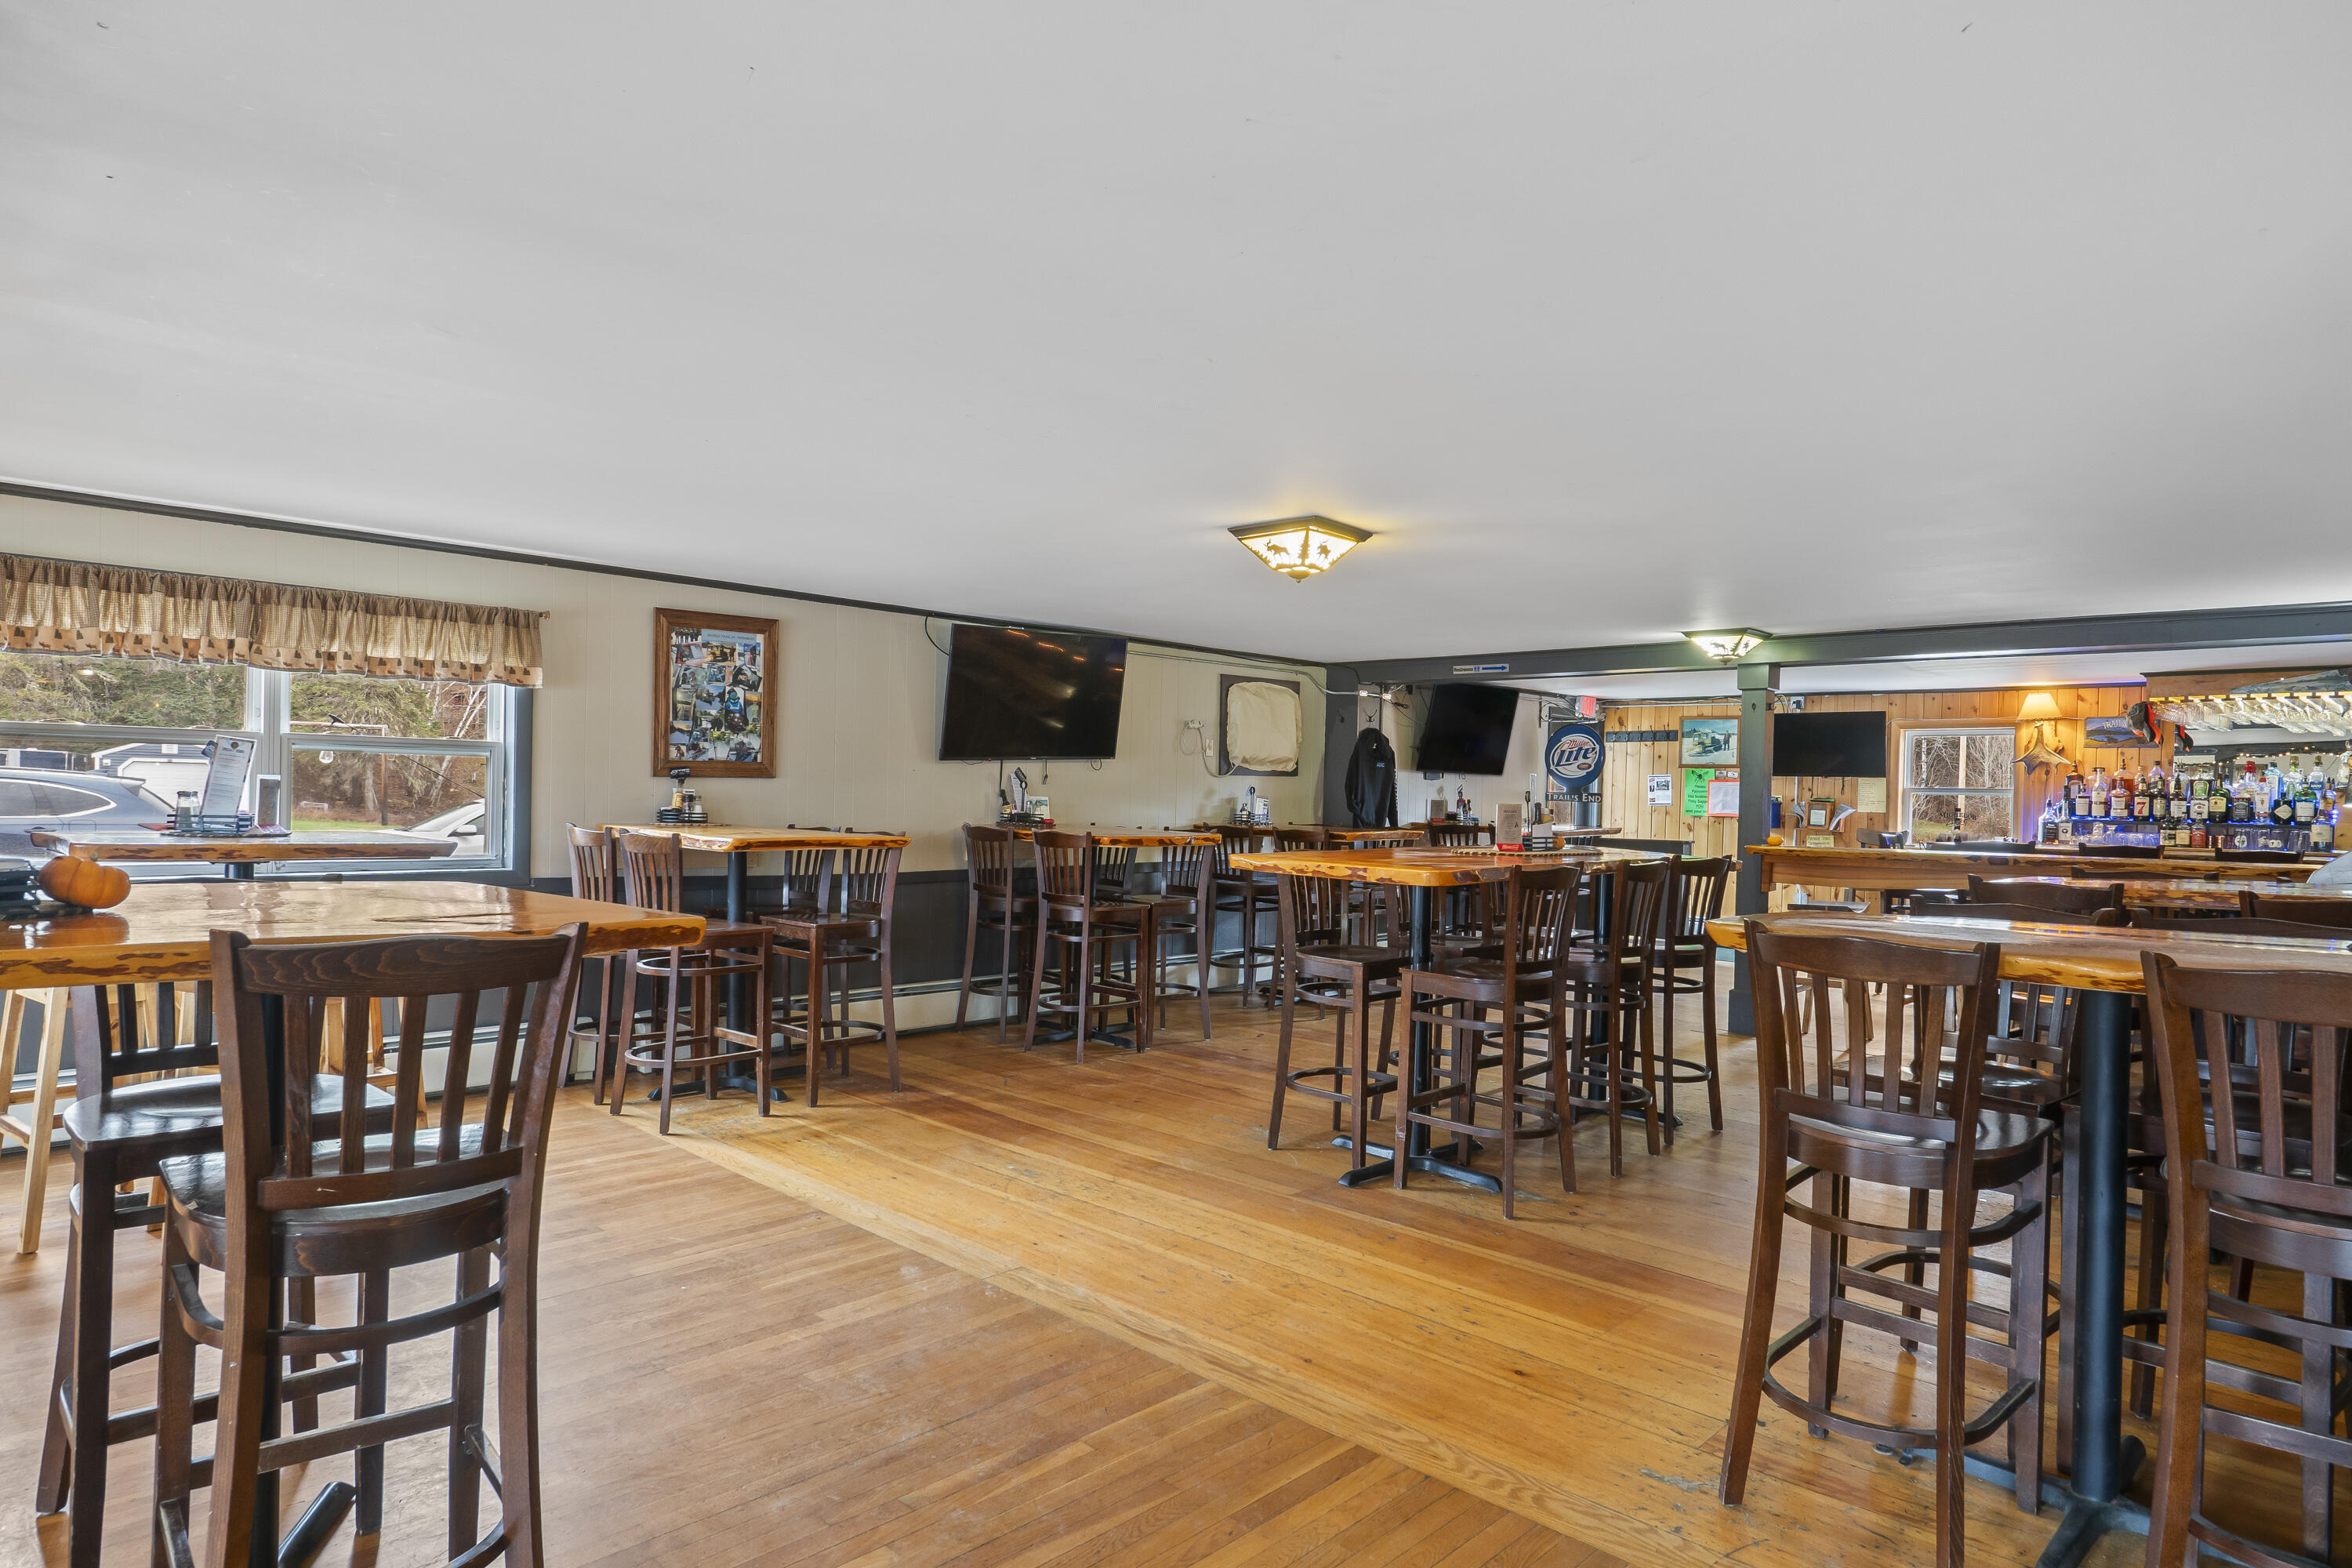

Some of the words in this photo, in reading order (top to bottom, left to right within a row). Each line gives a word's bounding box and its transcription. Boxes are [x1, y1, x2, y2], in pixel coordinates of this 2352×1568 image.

[1566, 739, 1591, 748] Miller
[1555, 746, 1597, 768] Lite
[2136, 802, 2147, 815] 7
[1940, 811, 1976, 821] MICHELOB
